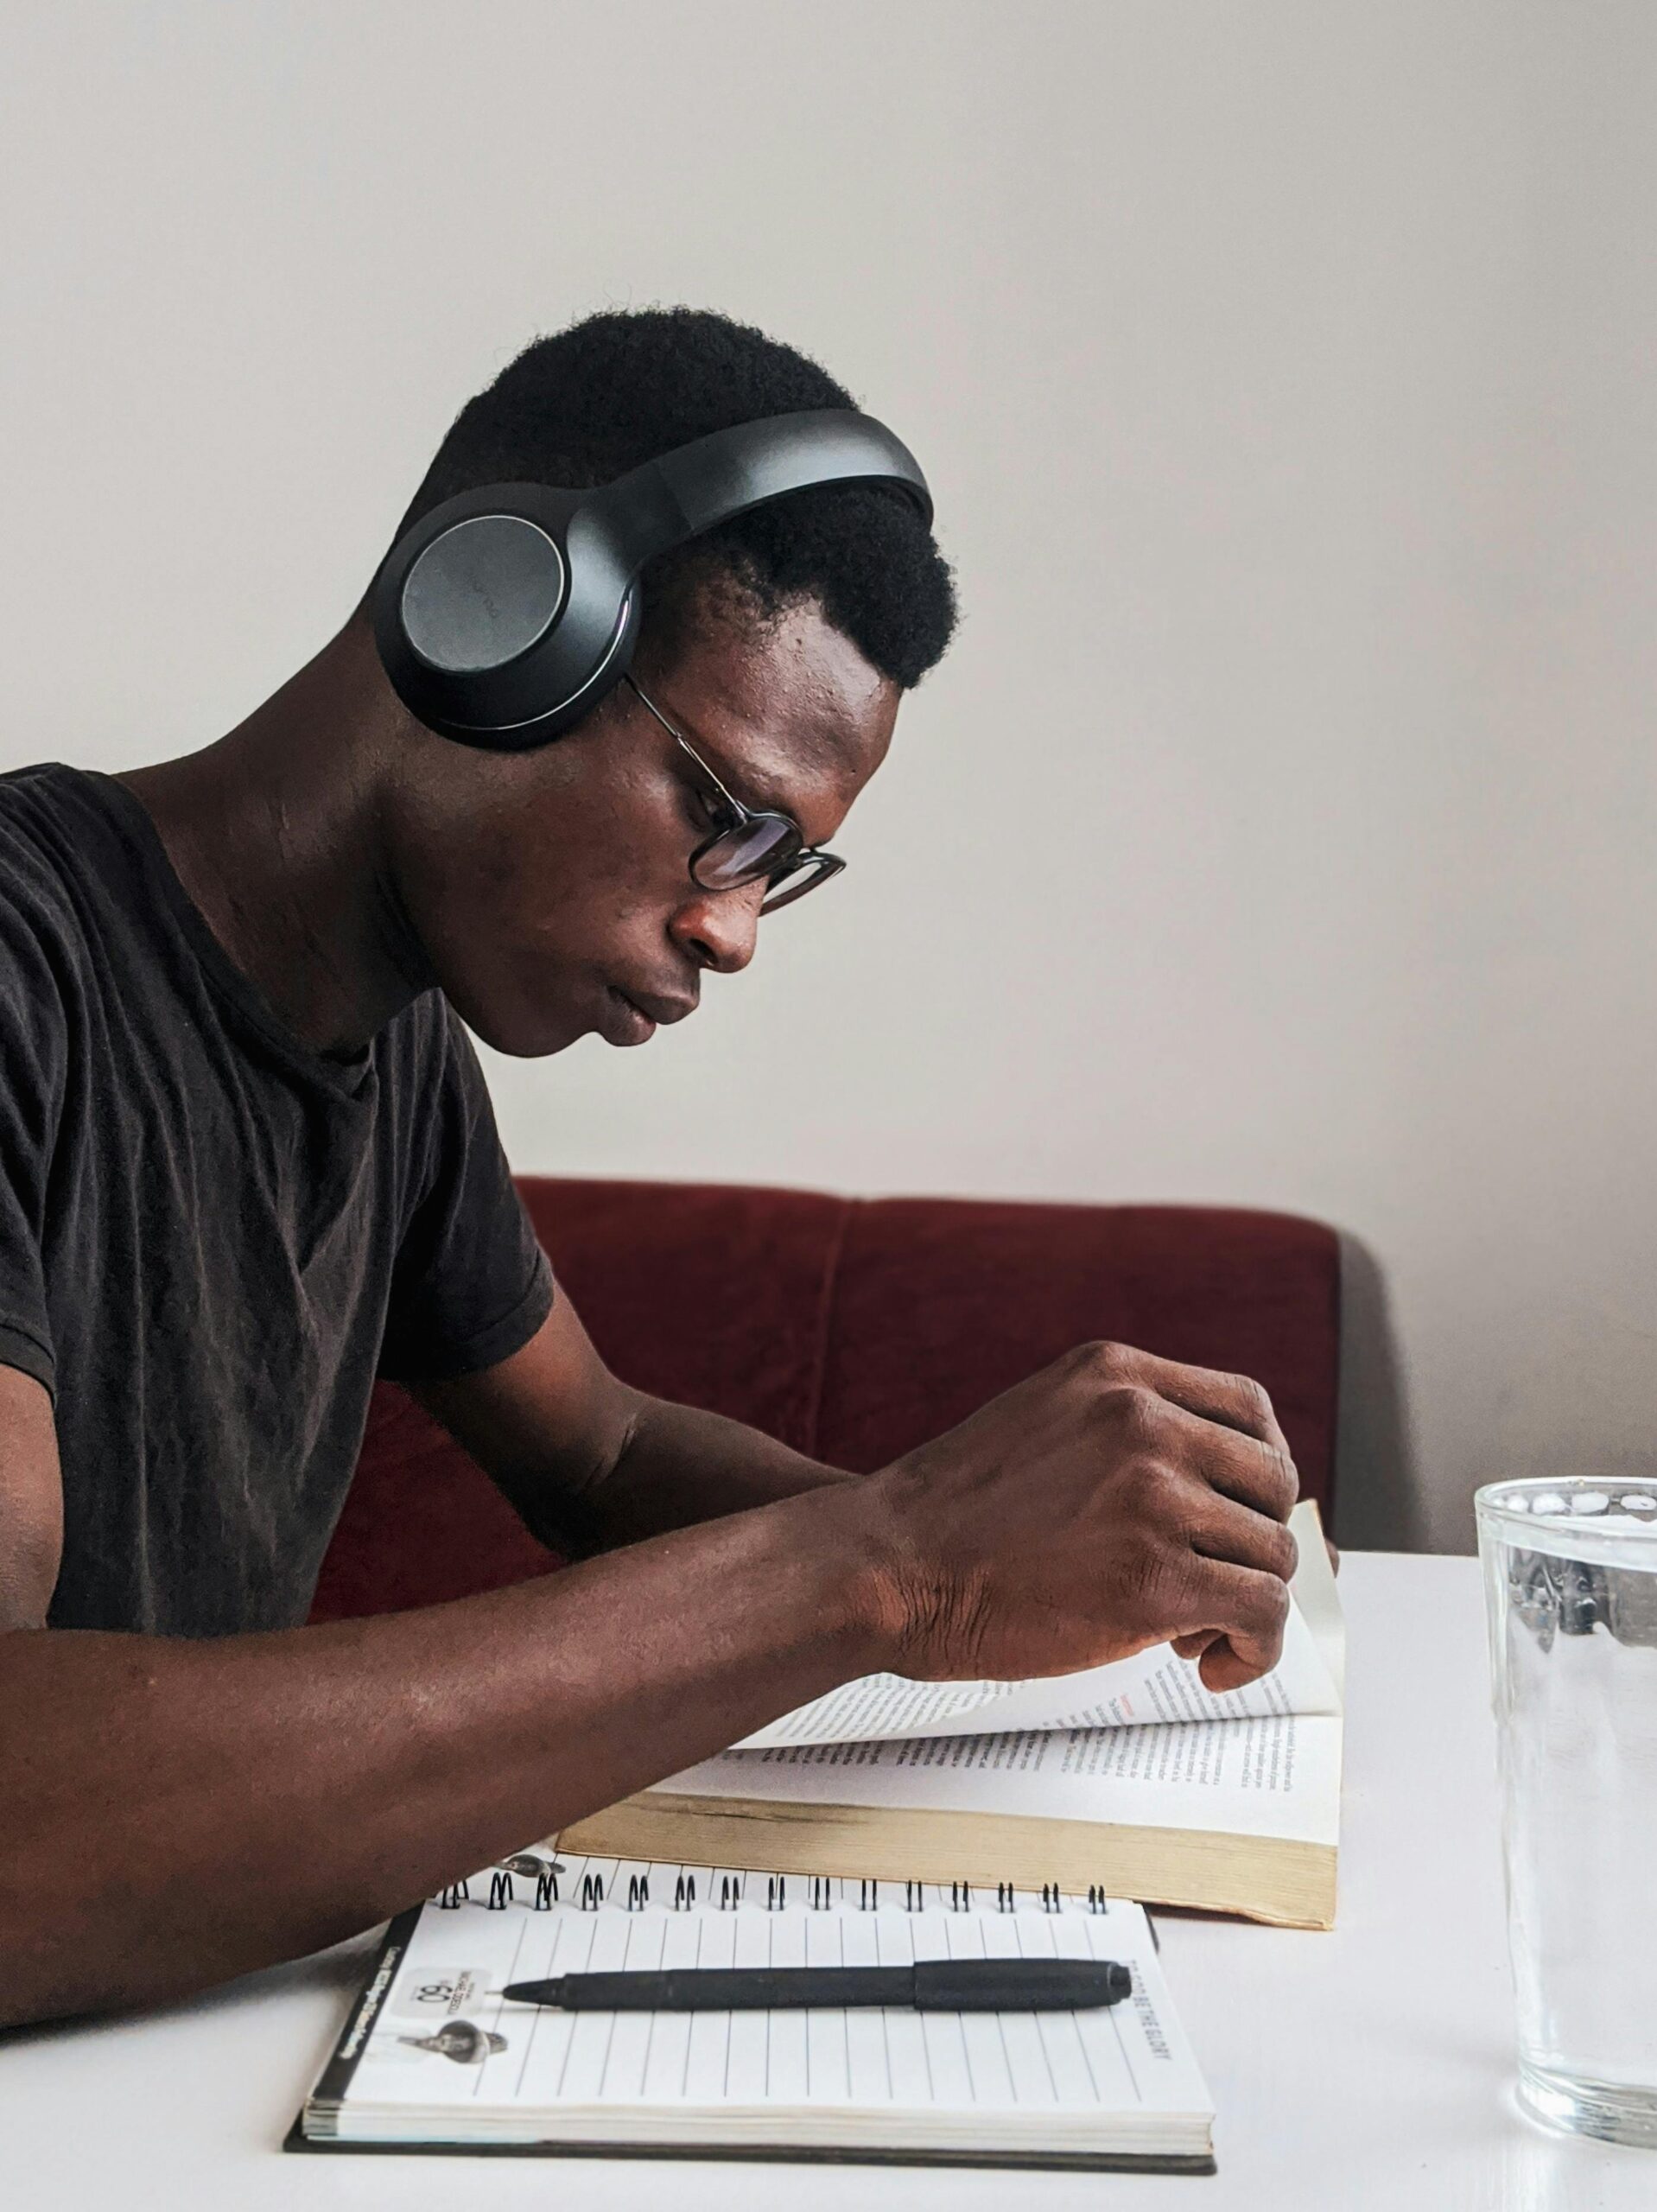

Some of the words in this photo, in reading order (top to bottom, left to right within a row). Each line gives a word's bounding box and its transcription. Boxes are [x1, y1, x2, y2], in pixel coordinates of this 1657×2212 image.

[1133, 1996, 1151, 2007] BE
[1137, 2009, 1159, 2026] THE
[1145, 2028, 1171, 2060] GLORY
